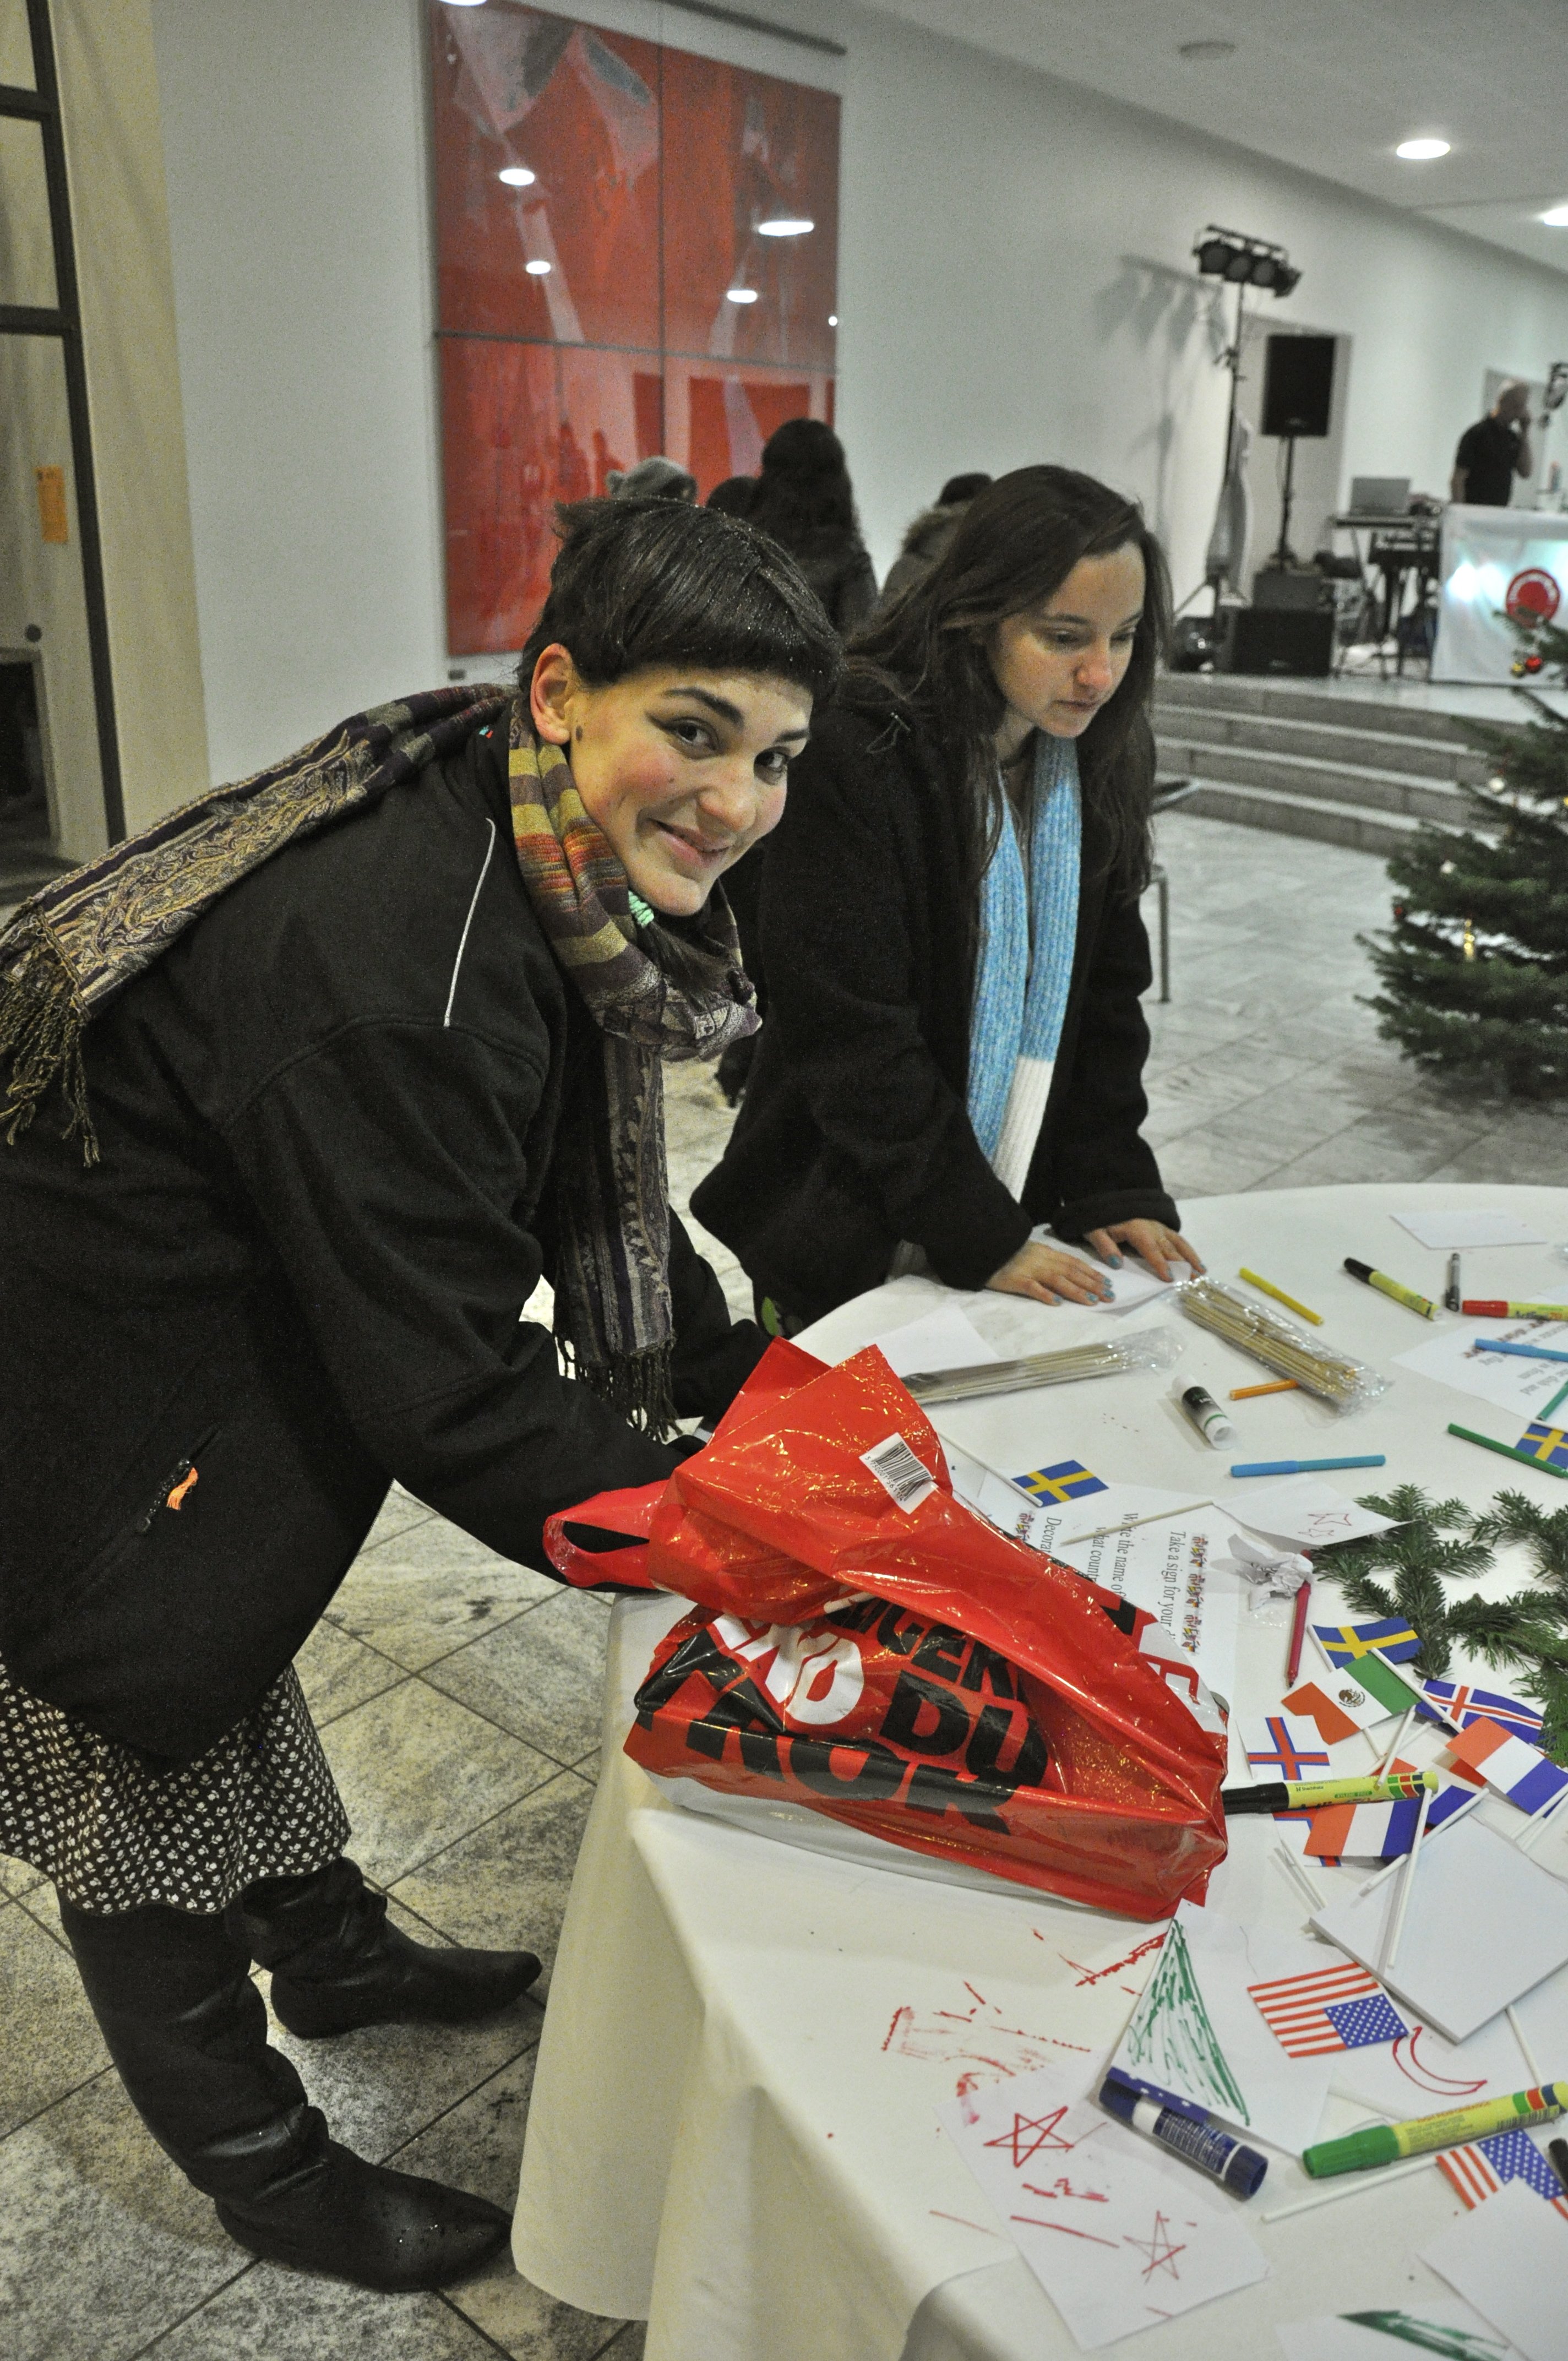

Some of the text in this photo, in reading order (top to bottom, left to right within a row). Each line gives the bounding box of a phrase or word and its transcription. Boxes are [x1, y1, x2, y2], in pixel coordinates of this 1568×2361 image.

[1040, 1516, 1063, 1553] Decorat
[1168, 1531, 1186, 1553] Take
[1087, 1550, 1102, 1582] countr
[1110, 1513, 1139, 1597] Wte the name of
[1161, 1563, 1183, 1583] sign
[1163, 1585, 1181, 1601] for
[1157, 1601, 1174, 1627] your
